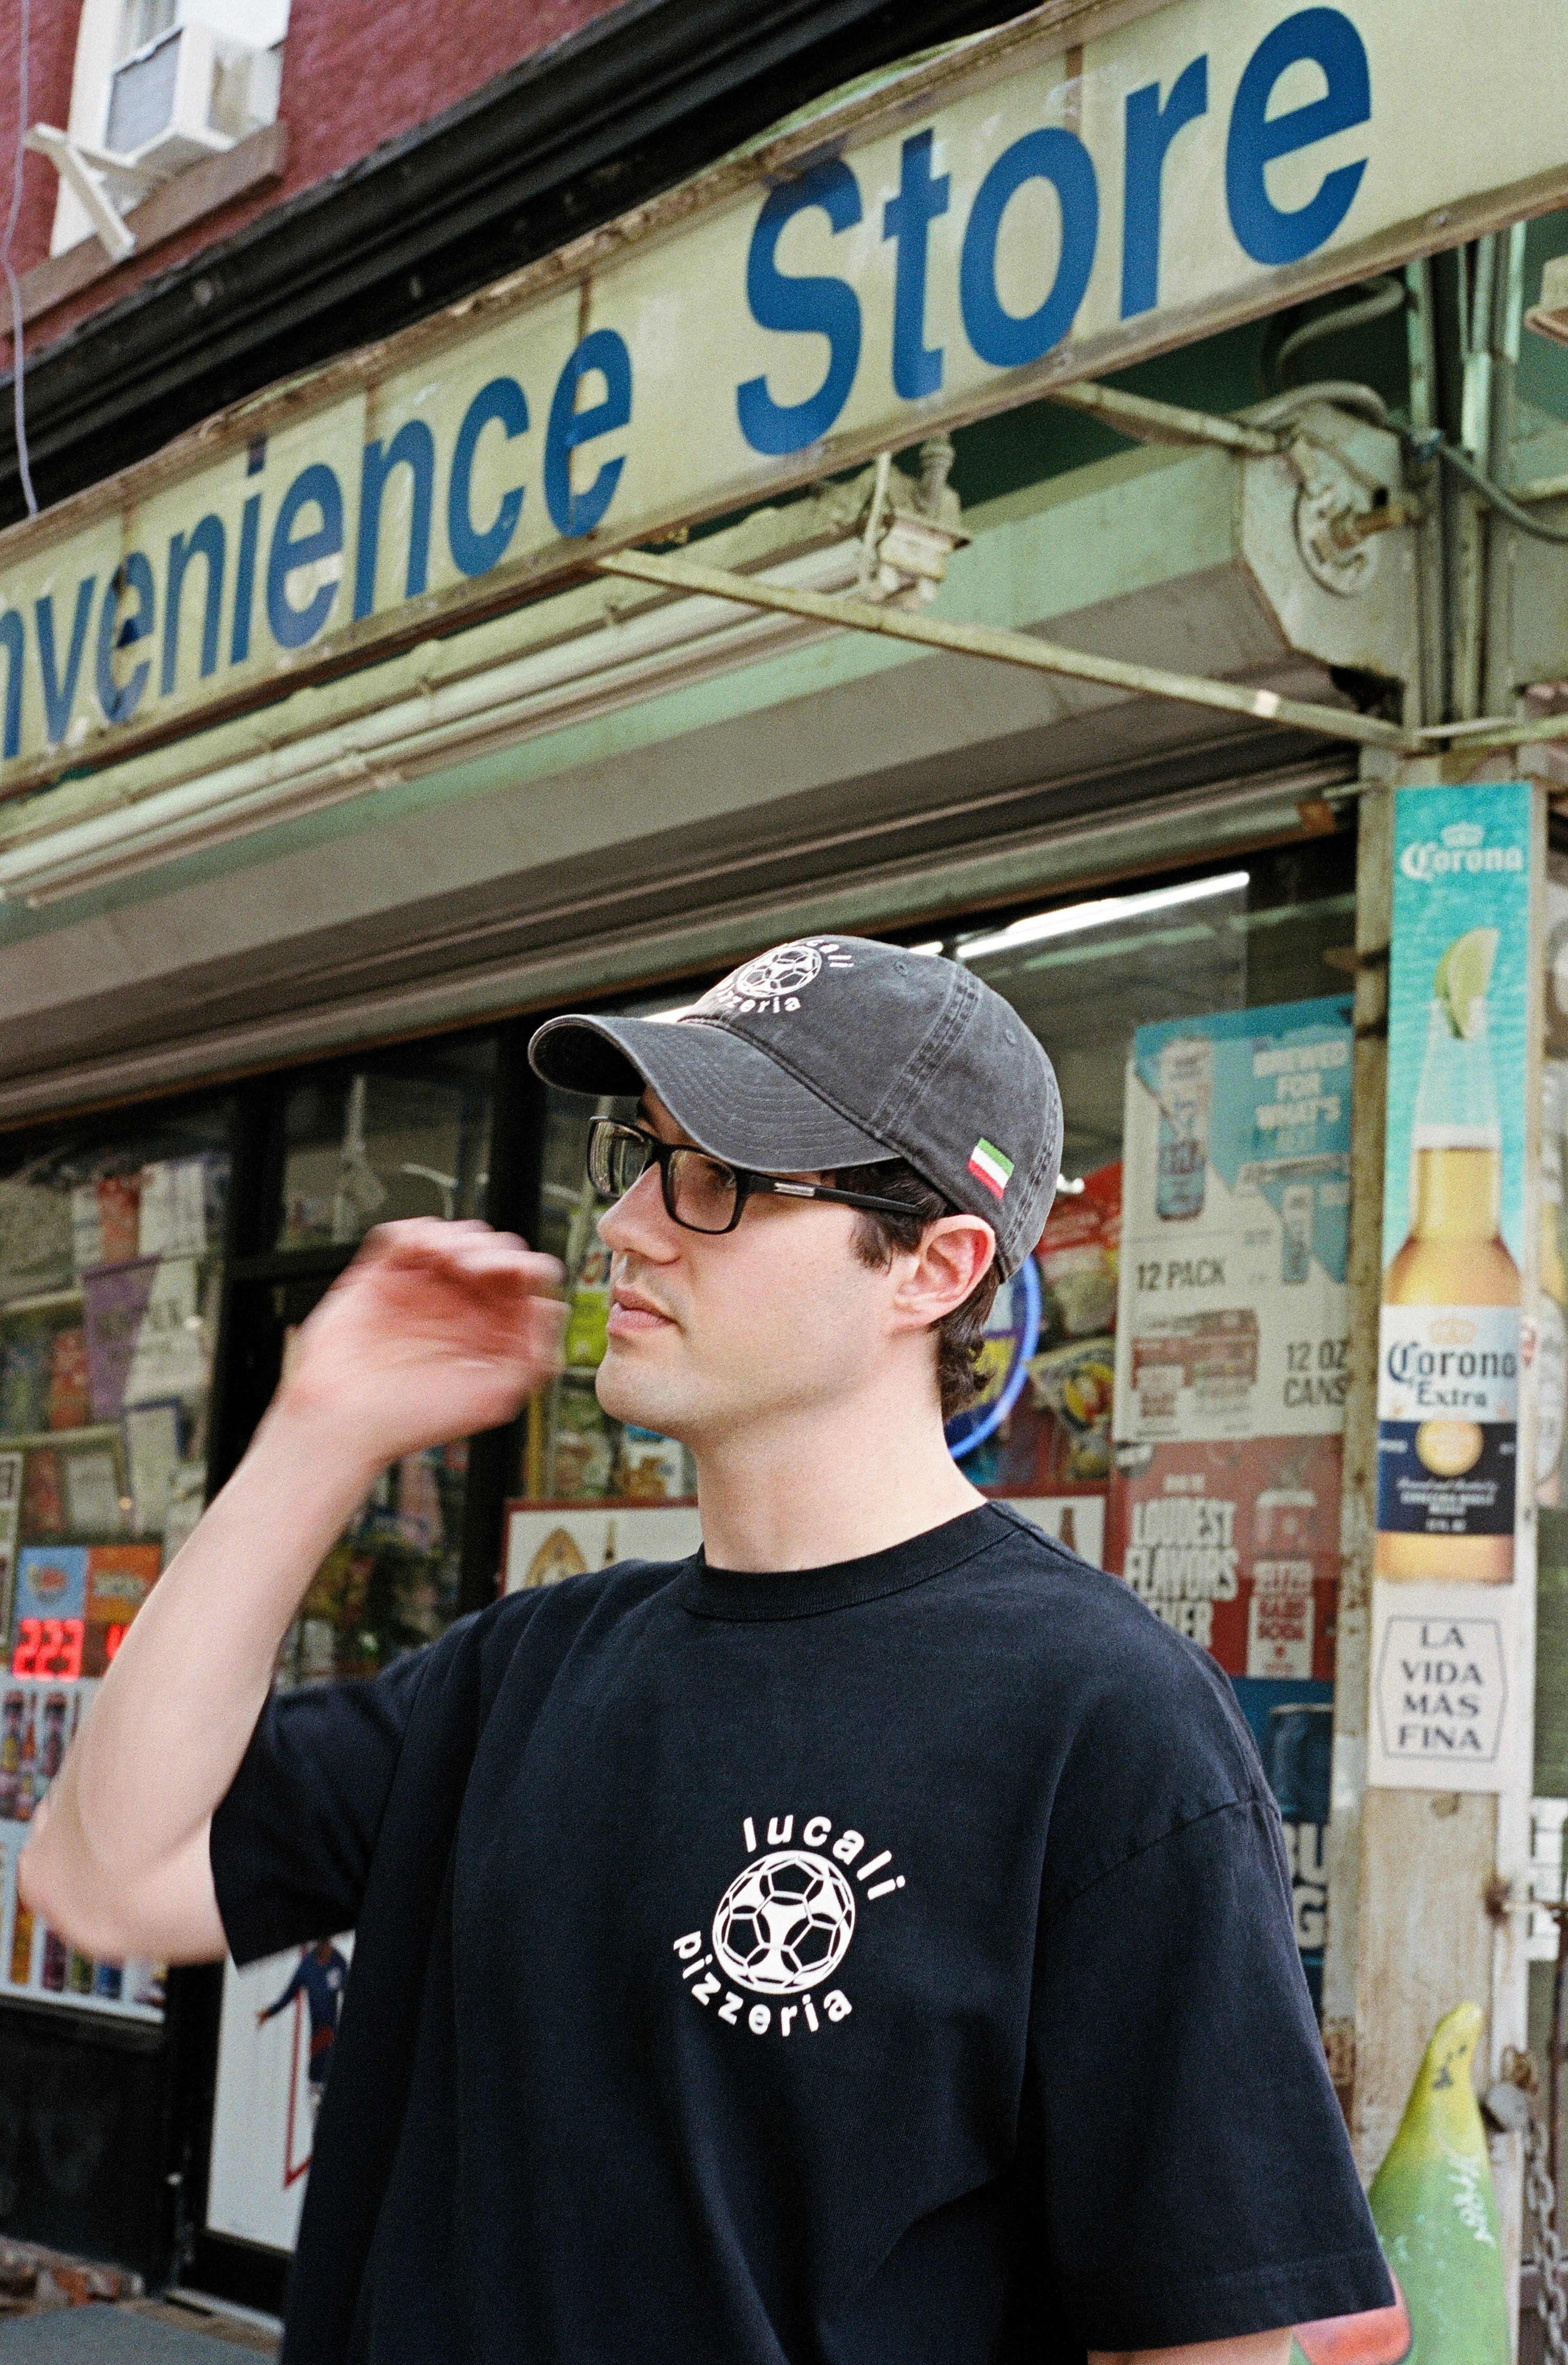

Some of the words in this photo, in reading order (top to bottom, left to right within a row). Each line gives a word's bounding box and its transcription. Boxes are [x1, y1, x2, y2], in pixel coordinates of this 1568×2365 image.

[736, 6, 1371, 457] Store
[1401, 841, 1524, 881] Corona
[1137, 1261, 1161, 1290] 12
[1167, 1257, 1226, 1289] PACK
[1287, 1341, 1311, 1372] 12
[1318, 1339, 1347, 1371] OZ
[1387, 1340, 1516, 1386] Corona
[1284, 1375, 1347, 1409] CANS
[1416, 1380, 1488, 1407] Extra
[1420, 1625, 1466, 1649] LA
[1401, 1659, 1483, 1686] VIDA
[1398, 1725, 1482, 1749] FINA
[743, 1814, 906, 1901] lucali
[673, 1931, 852, 2037] pizzeria
